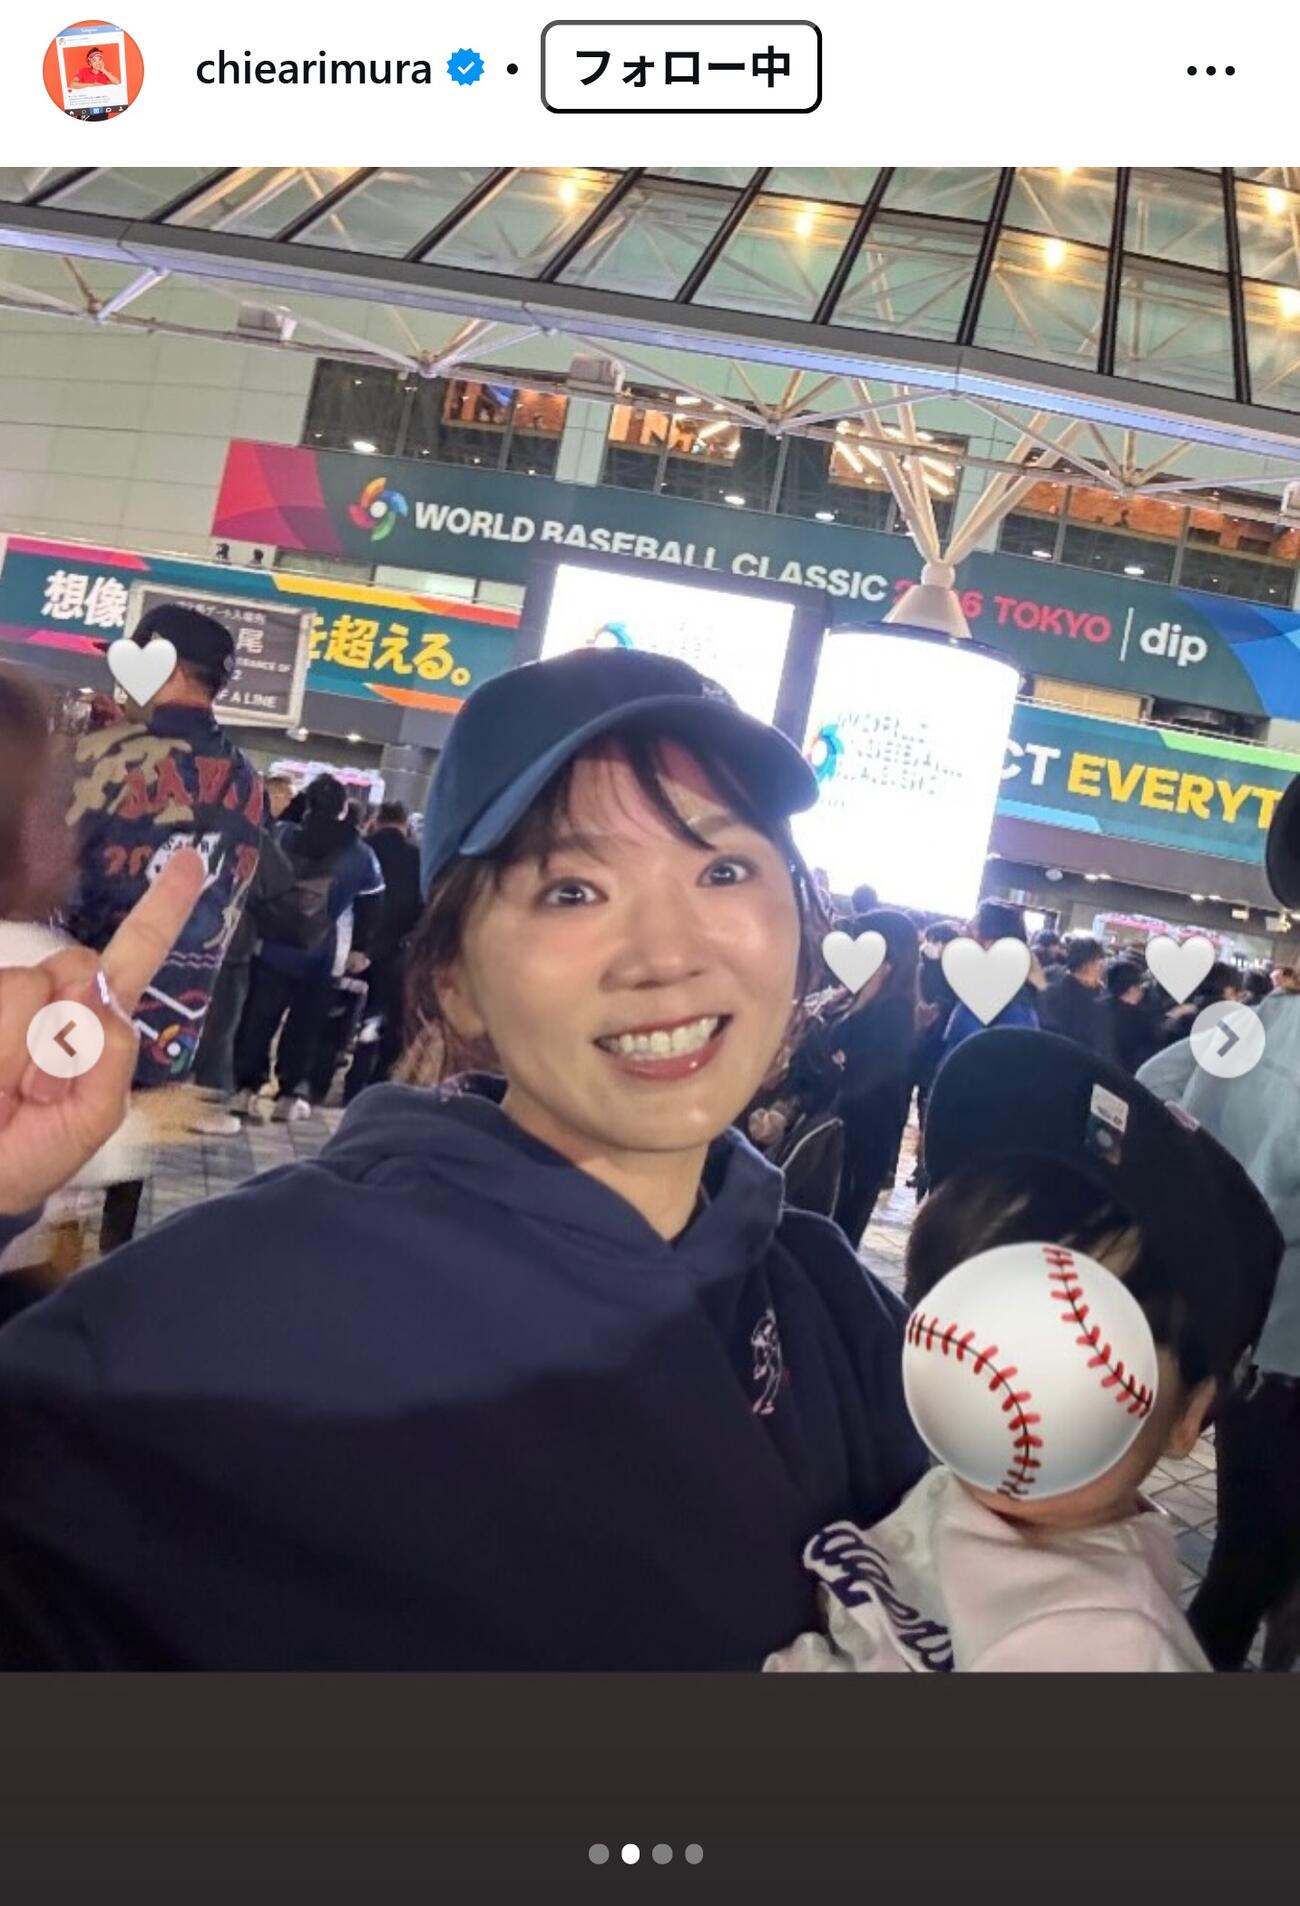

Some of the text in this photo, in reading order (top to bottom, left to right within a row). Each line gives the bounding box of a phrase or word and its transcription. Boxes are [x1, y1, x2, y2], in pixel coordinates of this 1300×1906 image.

[40, 569, 129, 628] 想像
[415, 501, 536, 544] WORLD
[541, 519, 723, 572] BASEBALL
[731, 552, 889, 602] CLASSIC
[994, 595, 1112, 644] TOKYO
[1139, 622, 1208, 668] dip
[229, 690, 241, 704] A
[243, 692, 278, 709] LINE
[1067, 752, 1285, 830] EVERYT
